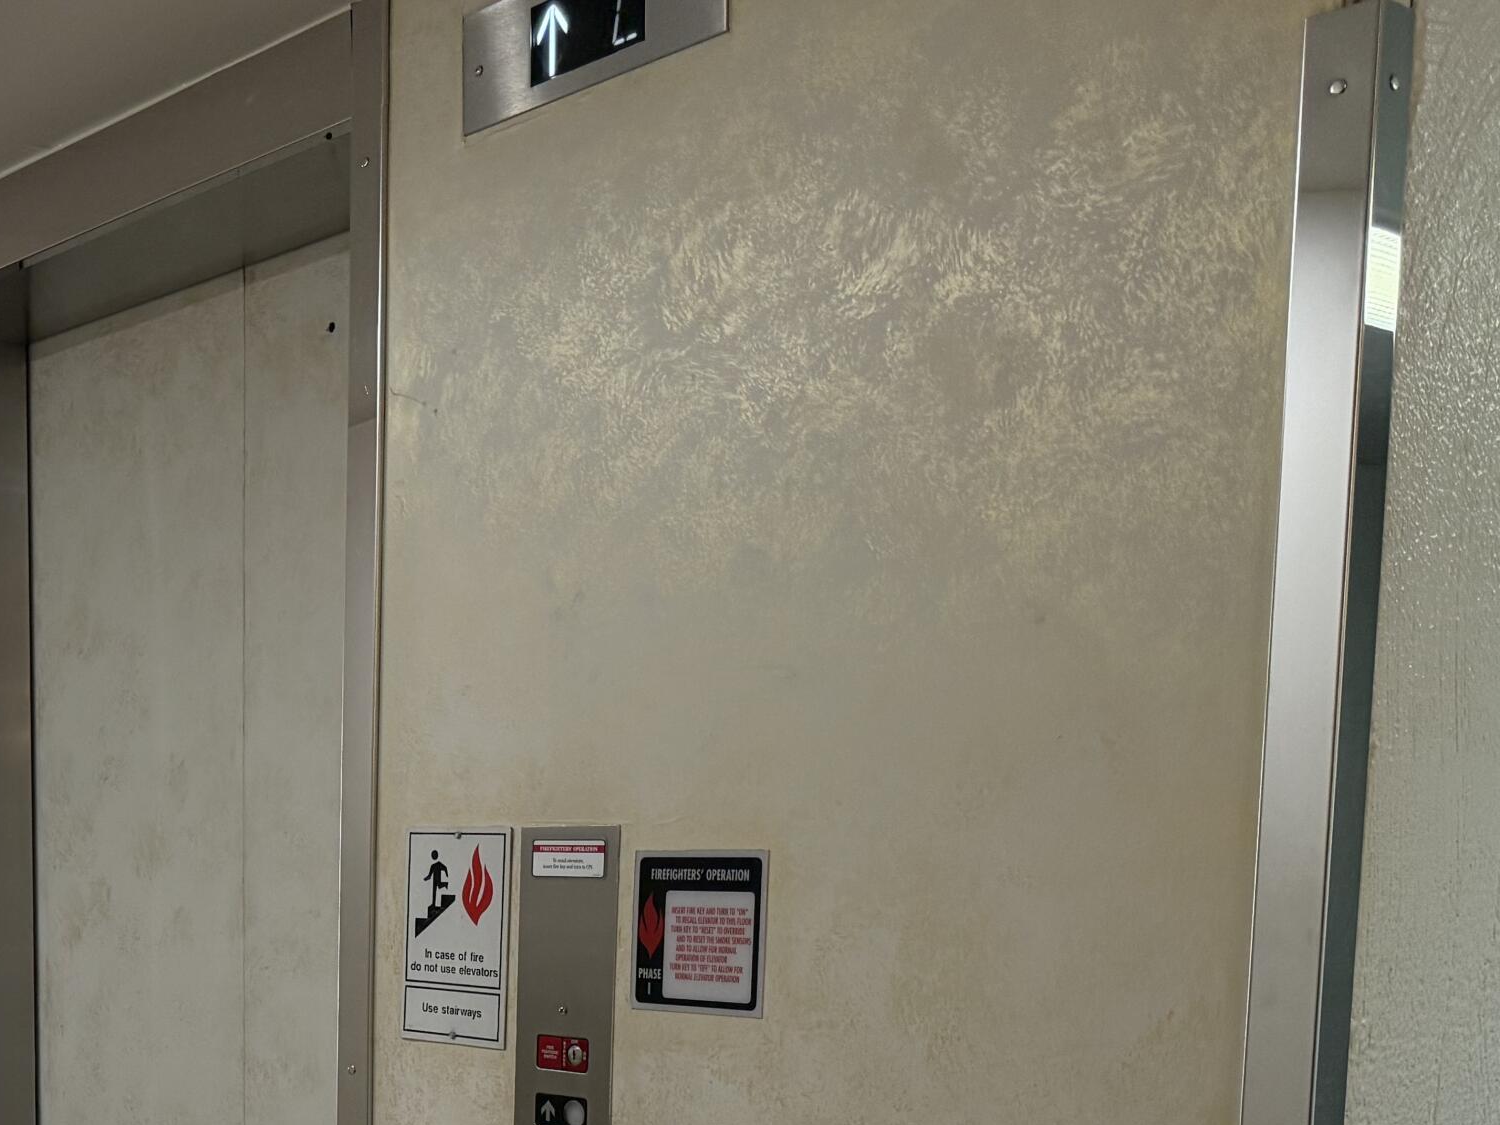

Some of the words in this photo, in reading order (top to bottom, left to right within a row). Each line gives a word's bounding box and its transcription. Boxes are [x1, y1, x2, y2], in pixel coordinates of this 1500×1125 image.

[651, 868, 704, 881] FIREFIGHTERS'
[706, 868, 750, 881] OPERATION
[425, 948, 432, 959] In
[435, 951, 455, 960] case
[458, 951, 467, 961] of
[470, 952, 484, 963] fire
[411, 961, 421, 971] do
[424, 963, 438, 972] not
[440, 966, 456, 974] use
[459, 965, 499, 978] elevators
[638, 967, 662, 980] PHASE
[422, 1002, 438, 1014] Use
[441, 1005, 482, 1020] stairways
